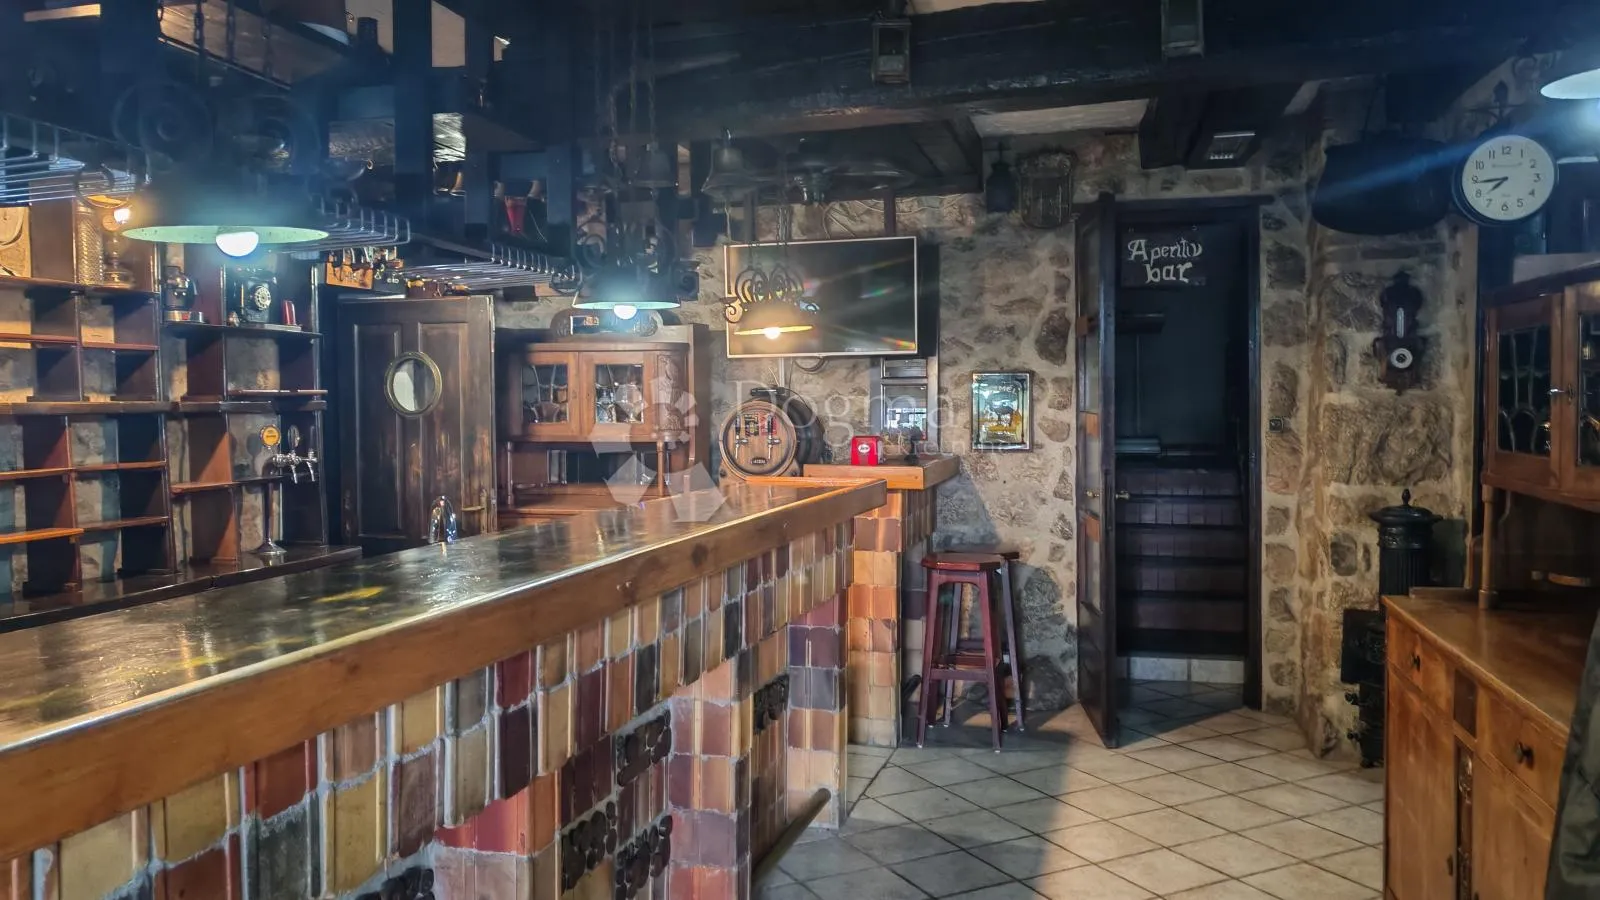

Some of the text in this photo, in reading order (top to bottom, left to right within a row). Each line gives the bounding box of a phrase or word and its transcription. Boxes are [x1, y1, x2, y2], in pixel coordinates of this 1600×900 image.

[1488, 149, 1496, 160] 11
[1501, 145, 1512, 156] 12
[1475, 160, 1485, 170] 10
[1529, 159, 1537, 169] 2
[1471, 174, 1479, 184] 9
[1533, 172, 1541, 183] 3
[1475, 188, 1482, 198] 8
[1528, 188, 1536, 198] 4
[1486, 198, 1493, 208] 7
[1501, 202, 1509, 212] 6
[1516, 198, 1524, 208] 5
[1127, 237, 1203, 266] Aperitiv
[1144, 261, 1193, 284] bar
